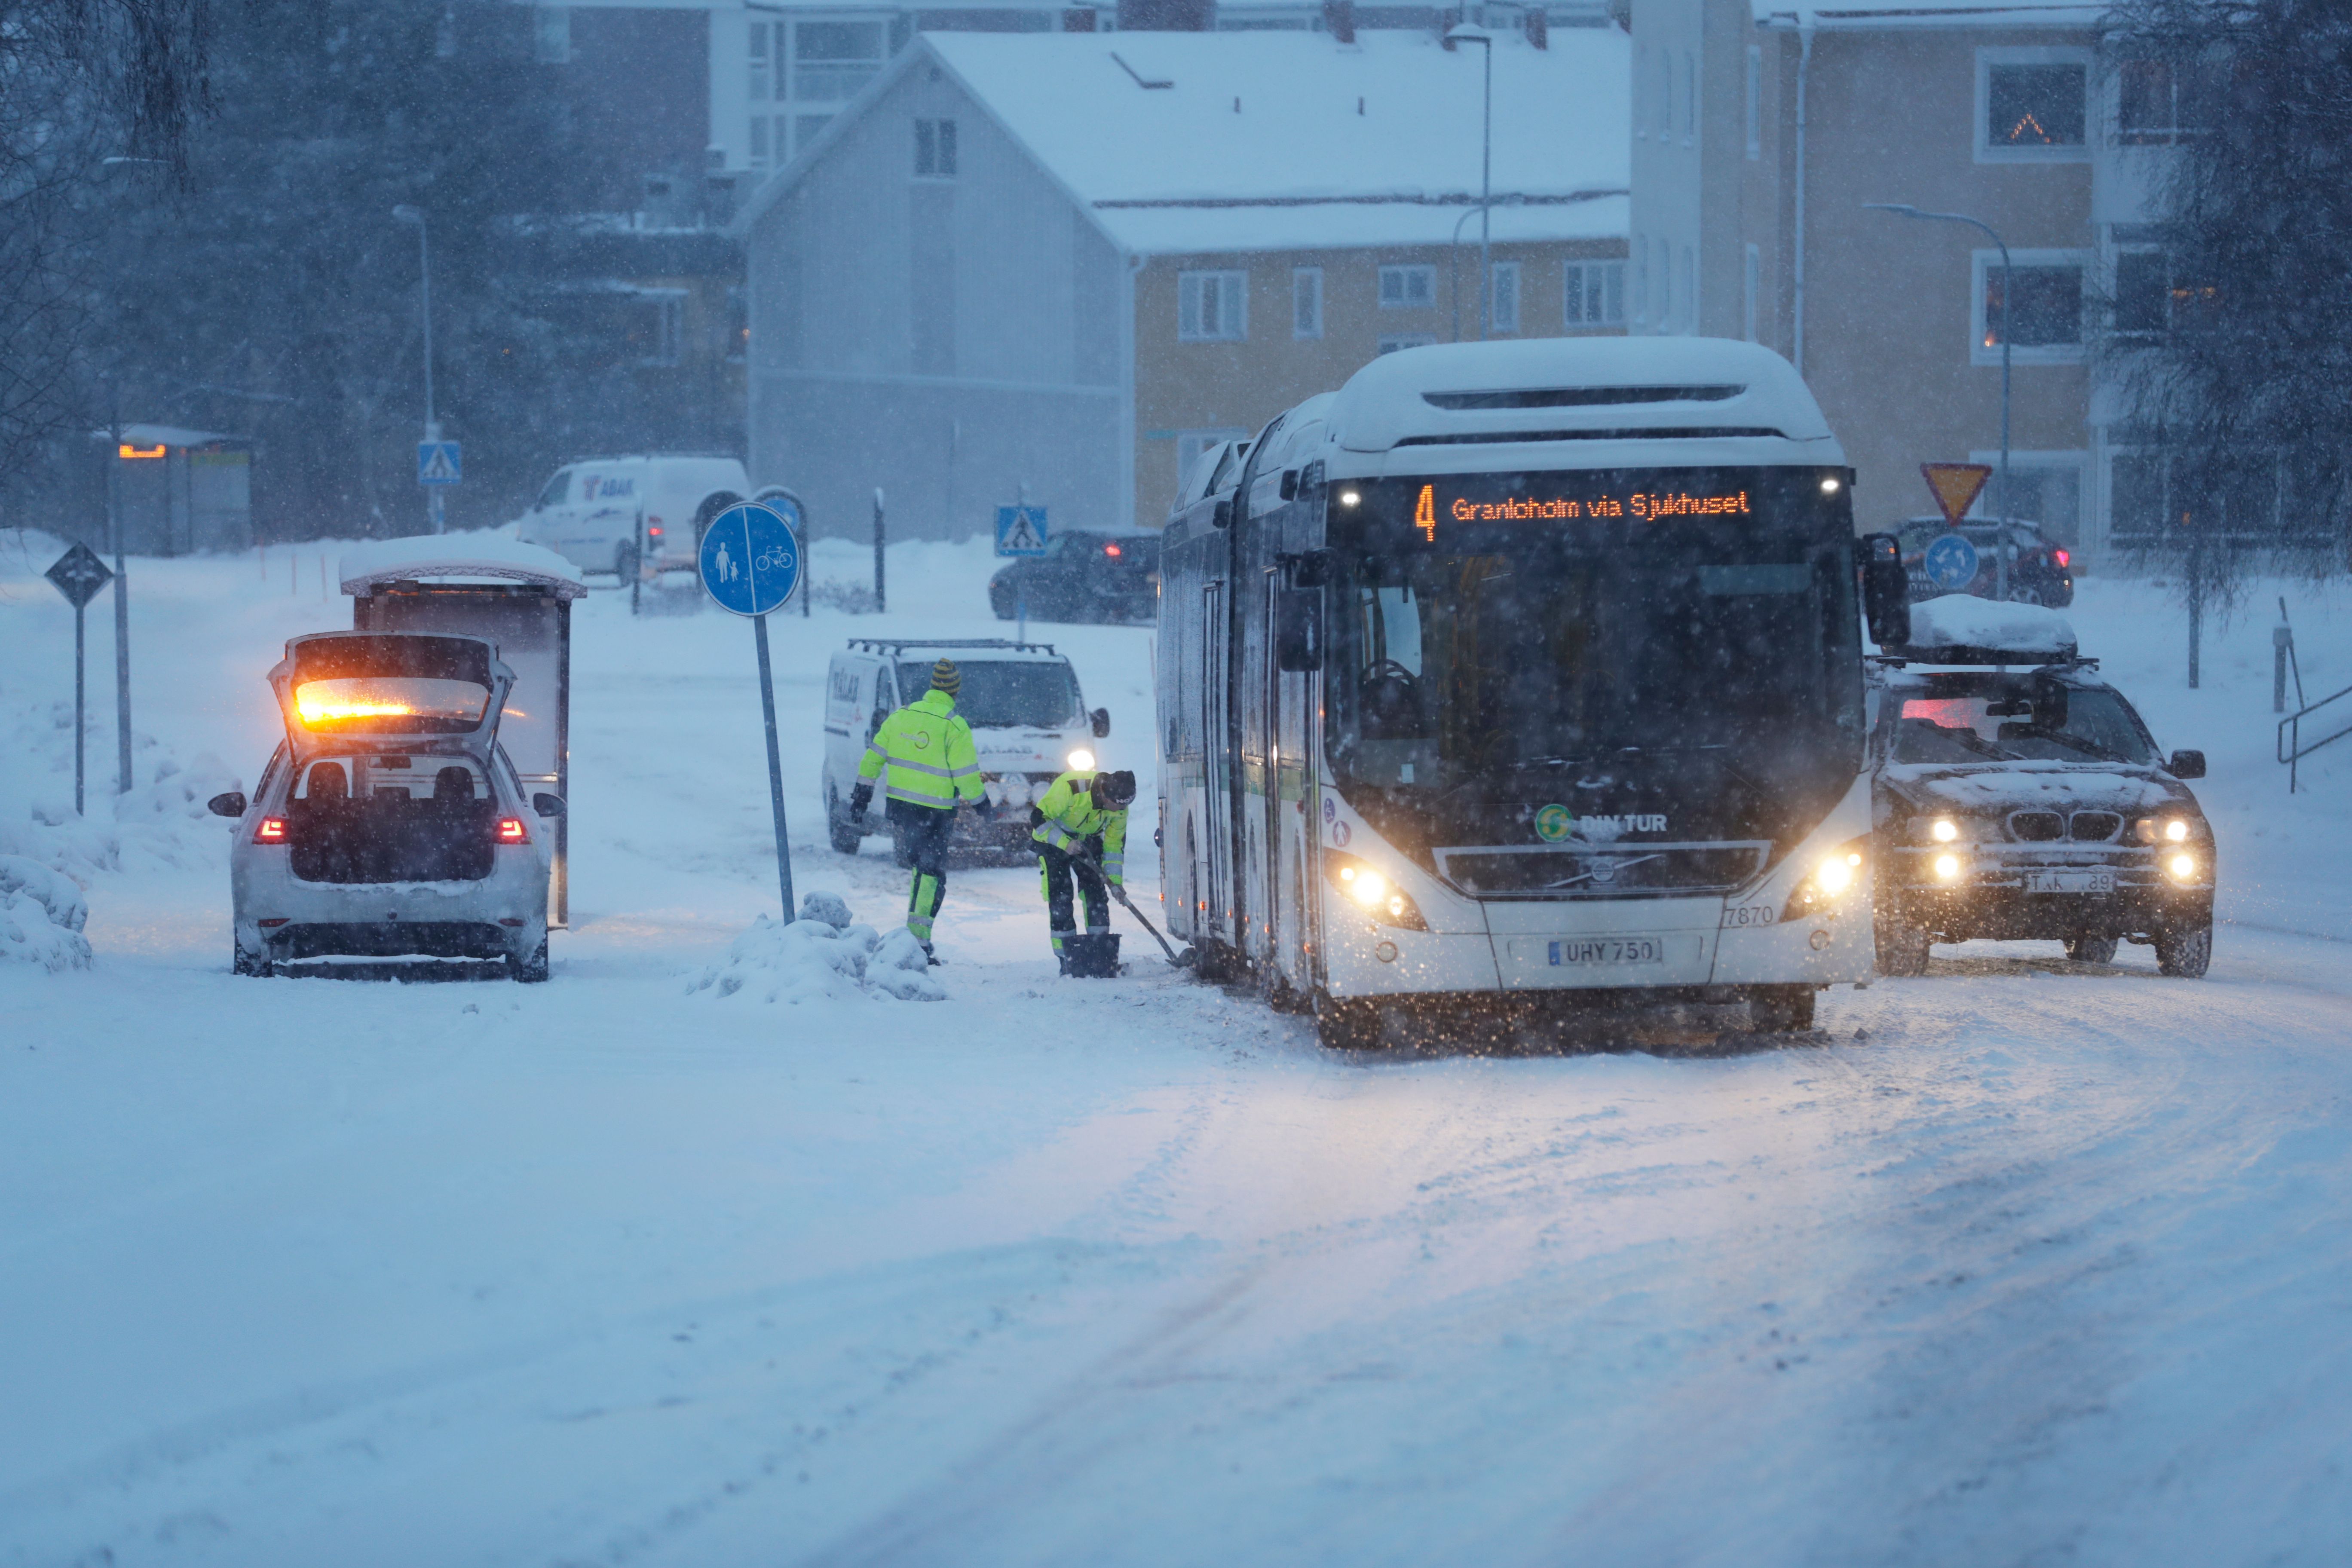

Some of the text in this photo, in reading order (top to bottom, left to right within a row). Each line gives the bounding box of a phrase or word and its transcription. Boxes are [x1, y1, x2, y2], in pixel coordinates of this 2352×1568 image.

[1415, 484, 1750, 542] 4 Granloholm via Sjukhuset
[1624, 814, 1667, 832] TUR
[1725, 906, 1773, 925] 7870
[1568, 942, 1653, 962] UHY 750
